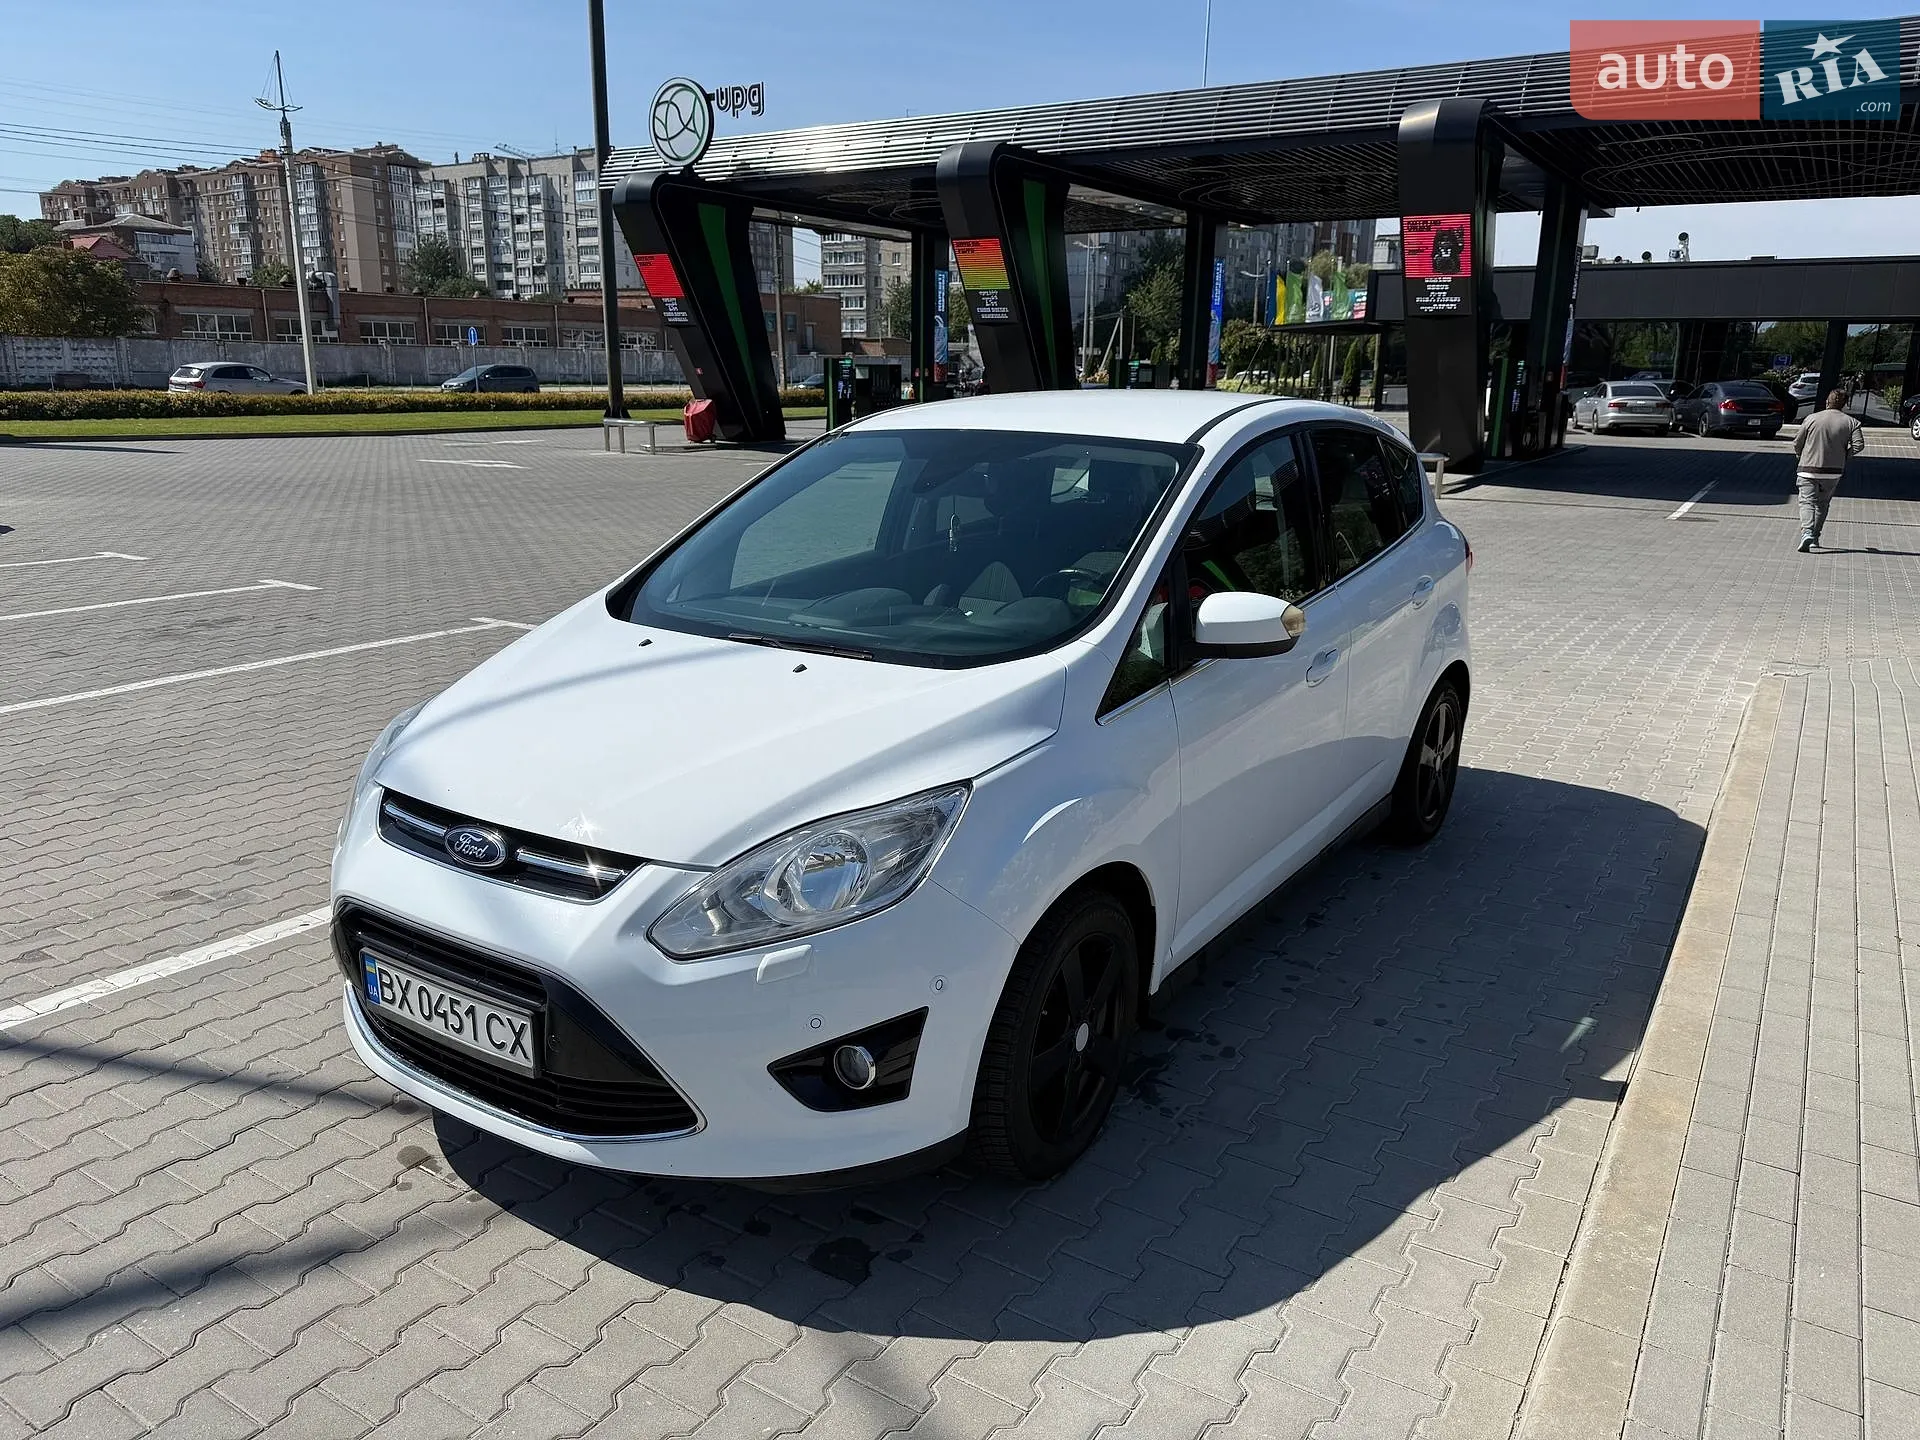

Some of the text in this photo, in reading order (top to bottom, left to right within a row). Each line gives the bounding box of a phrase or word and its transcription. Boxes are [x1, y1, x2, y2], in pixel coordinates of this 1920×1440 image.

[716, 82, 765, 119] upg
[454, 833, 489, 859] Ford
[367, 983, 379, 998] UA
[378, 966, 530, 1060] BX 0451 CX
